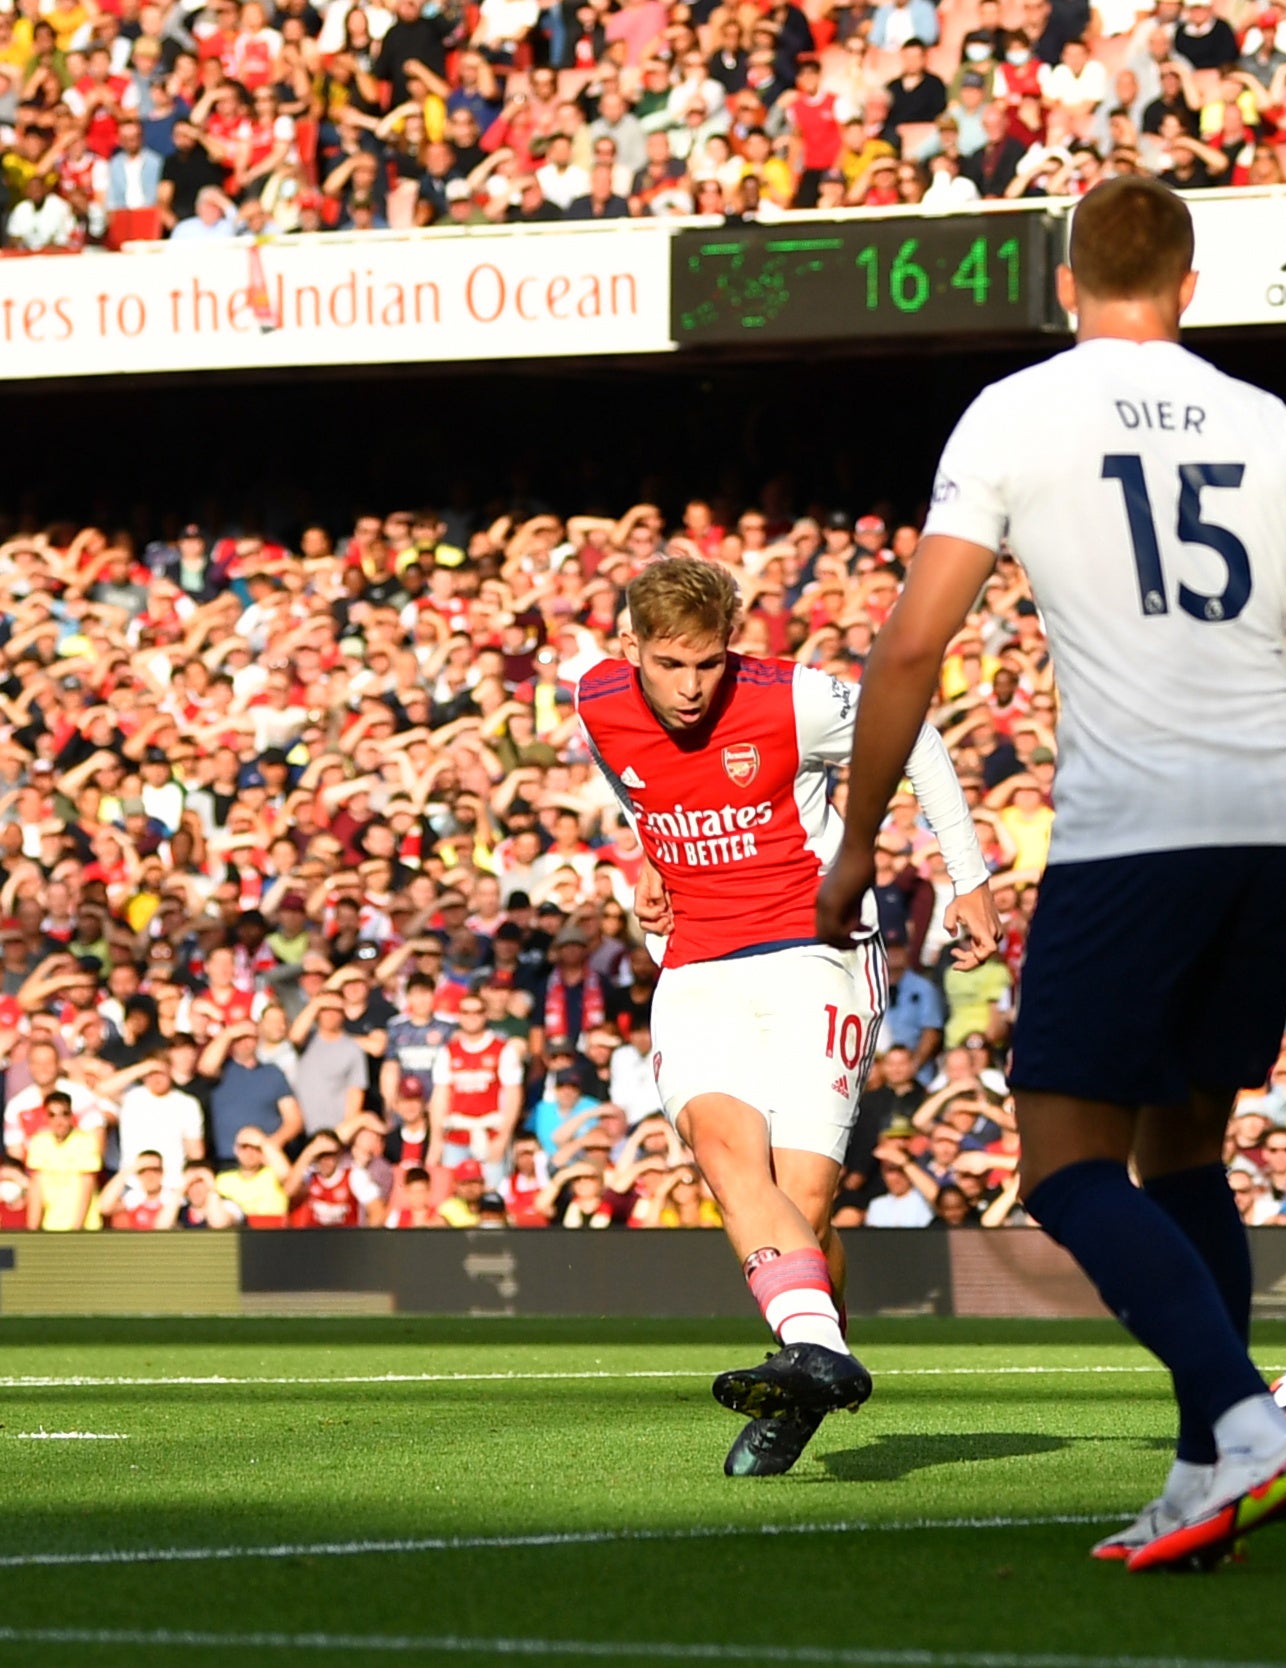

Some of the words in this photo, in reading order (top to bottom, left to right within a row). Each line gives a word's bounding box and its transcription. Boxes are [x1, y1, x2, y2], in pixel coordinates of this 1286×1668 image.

[97, 292, 147, 338] to
[169, 275, 252, 333] the
[275, 268, 441, 330] Indian
[464, 262, 638, 324] Ocean
[1114, 398, 1207, 434] DIER
[1101, 453, 1252, 623] 15
[683, 832, 758, 867] BETTER
[824, 1004, 862, 1070] 10
